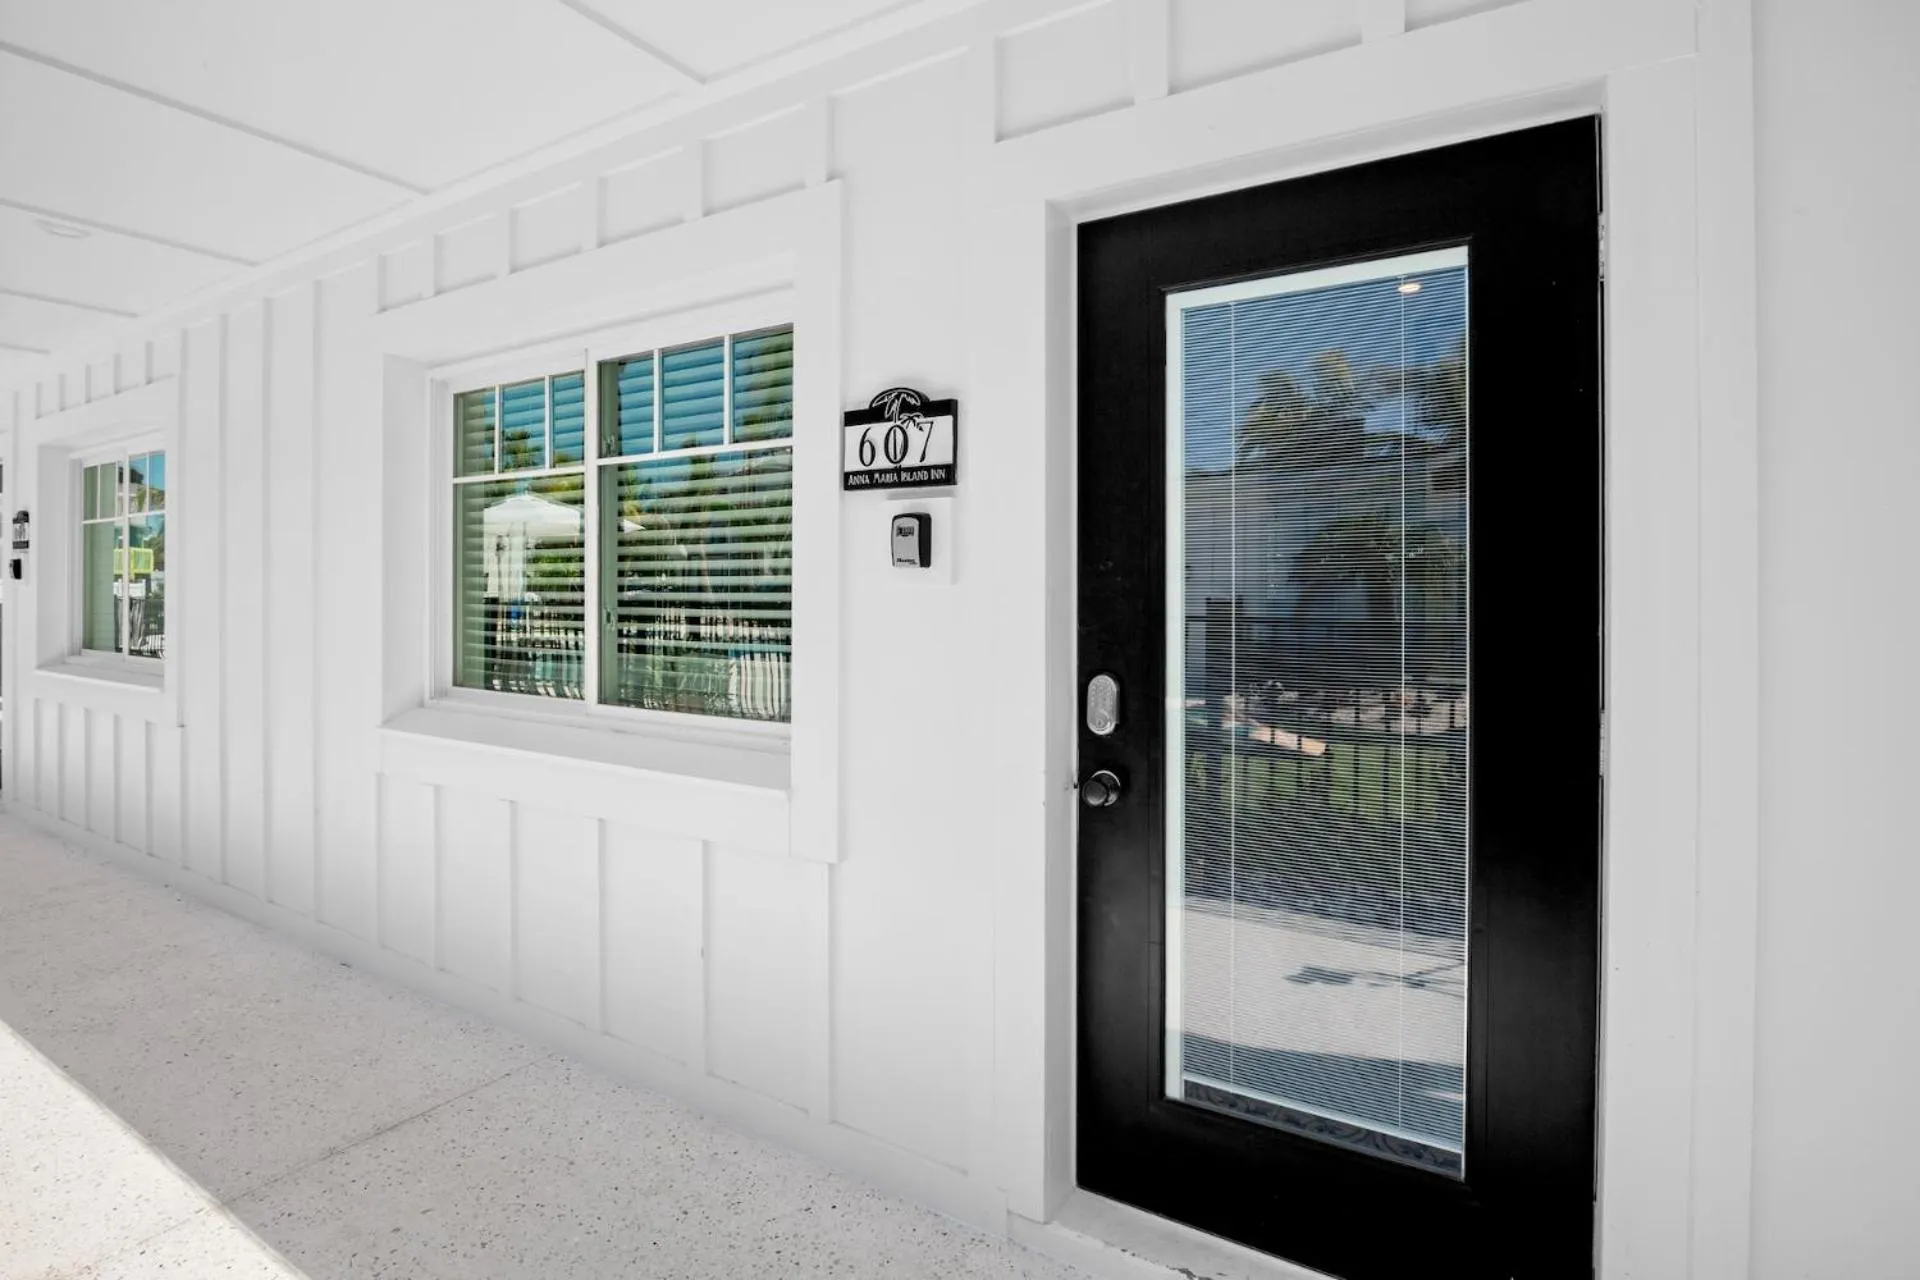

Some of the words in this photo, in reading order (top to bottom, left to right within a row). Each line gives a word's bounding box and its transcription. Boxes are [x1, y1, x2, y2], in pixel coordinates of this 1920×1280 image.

[859, 421, 934, 467] 607
[848, 474, 870, 486] ANNA
[931, 468, 946, 480] INN
